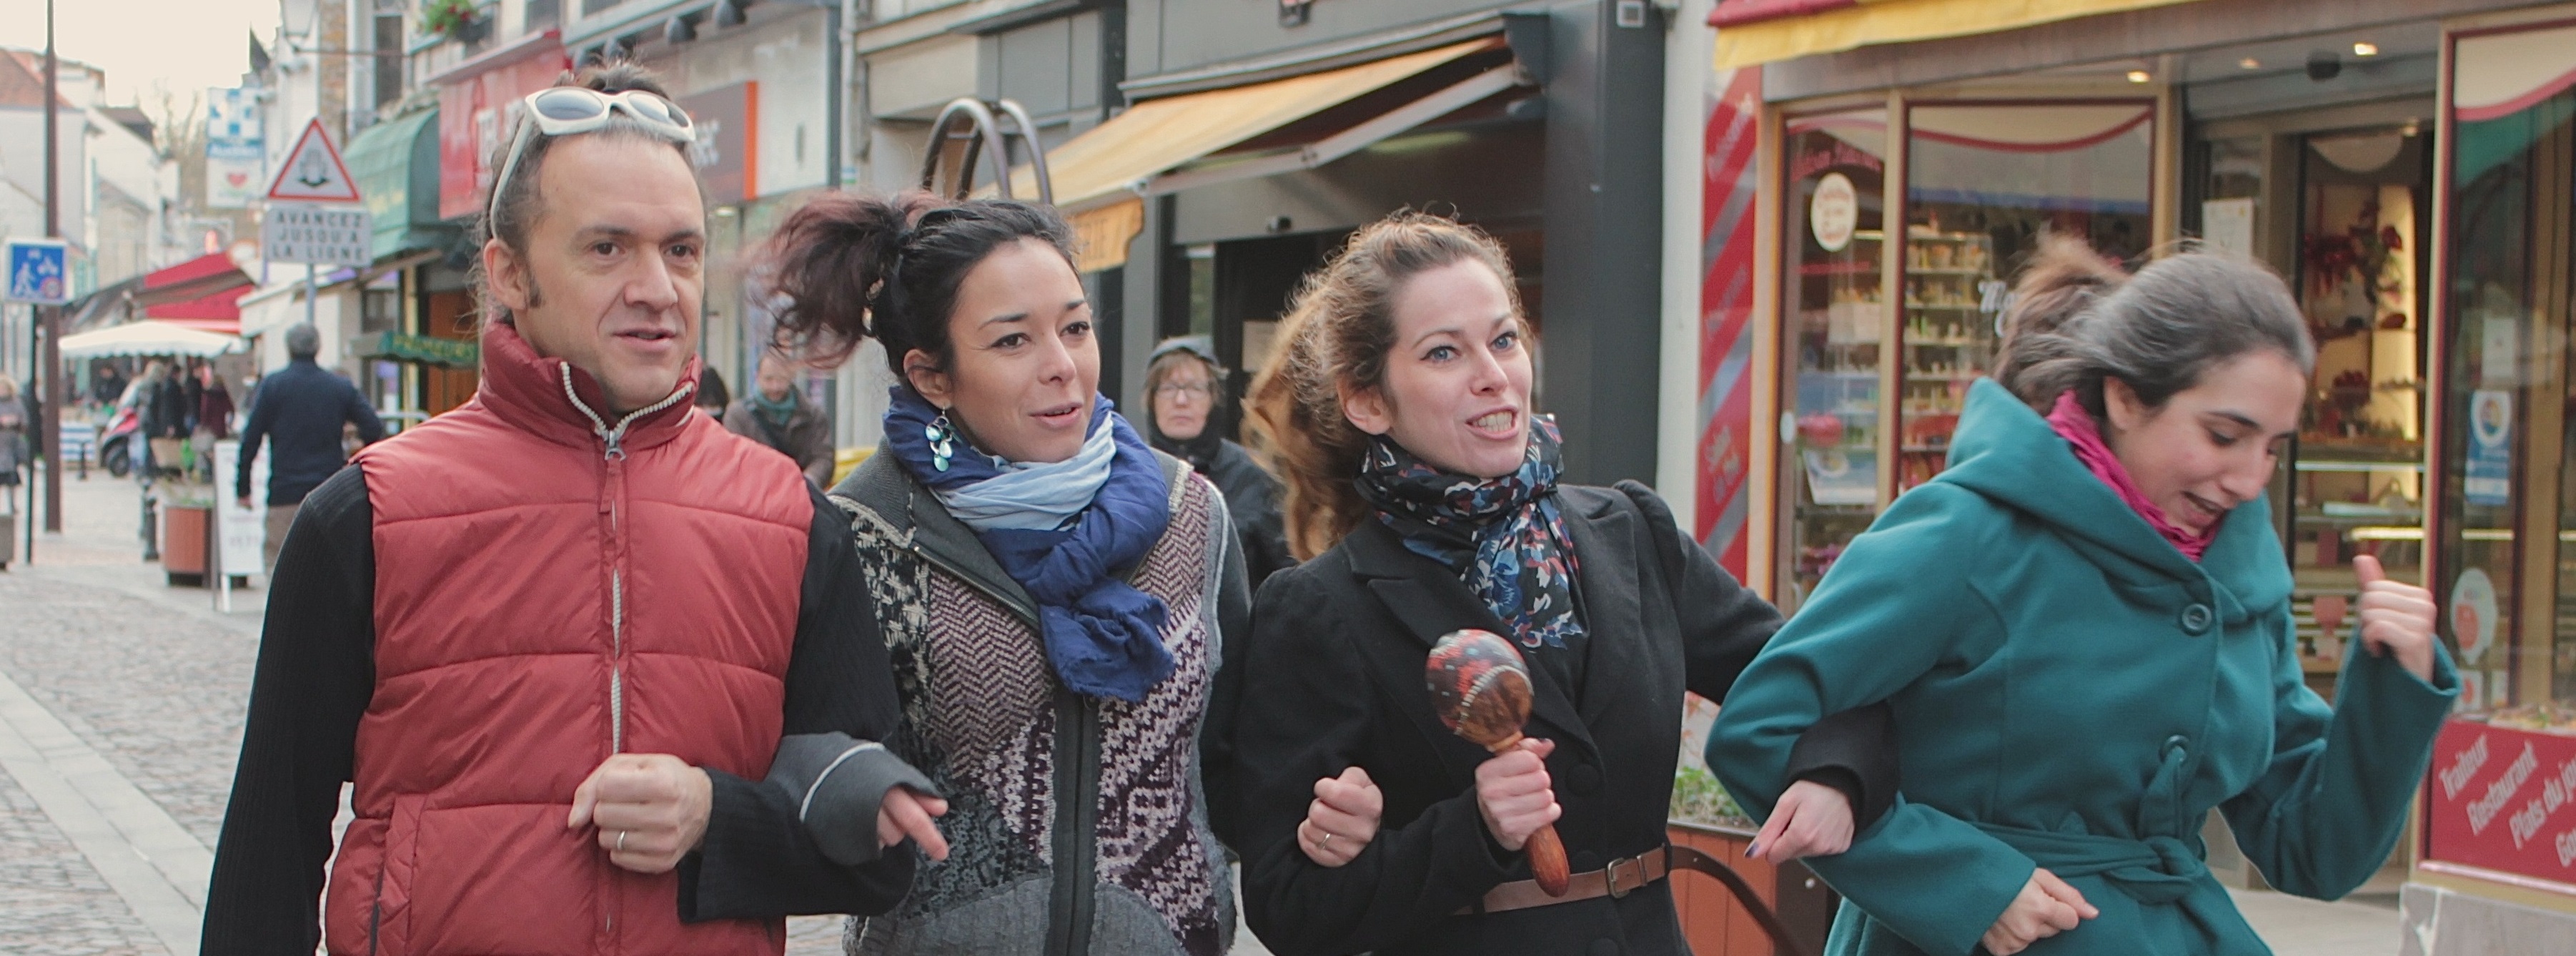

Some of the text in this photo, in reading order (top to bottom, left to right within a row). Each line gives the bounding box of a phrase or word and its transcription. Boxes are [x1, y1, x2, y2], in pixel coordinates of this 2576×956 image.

[277, 211, 362, 227] AVANCEZ
[277, 227, 357, 244] JUSQUA
[272, 242, 362, 261] LA LIGNE
[2438, 732, 2489, 802] Traiteur
[2466, 739, 2538, 837] Restaurant
[2509, 754, 2576, 851] Plats du jo
